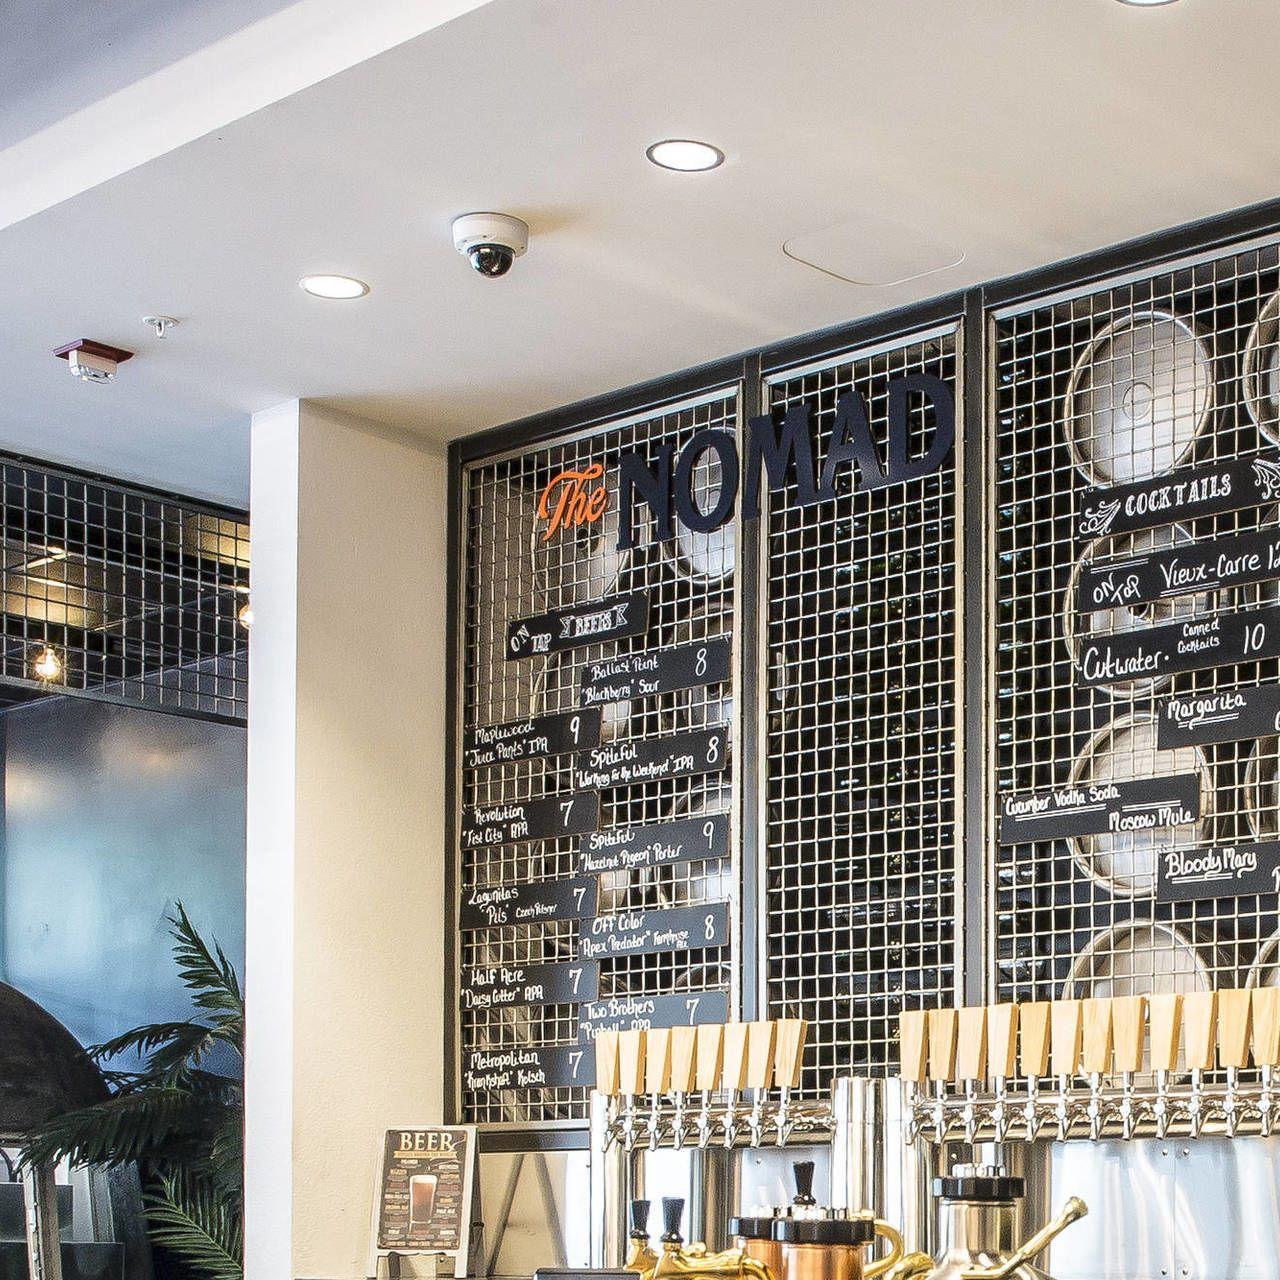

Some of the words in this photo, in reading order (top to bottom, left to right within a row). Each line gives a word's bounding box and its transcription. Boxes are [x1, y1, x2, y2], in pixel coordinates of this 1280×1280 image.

[539, 463, 607, 542] The
[617, 374, 955, 551] NOMAD
[1125, 473, 1232, 516] COCKTAILS
[1093, 572, 1114, 603] ON
[510, 624, 530, 652] ON
[531, 633, 552, 652] TAP
[575, 612, 612, 636] BEERS
[1183, 618, 1221, 638] Canned
[1083, 647, 1161, 681] Cutwater
[1243, 623, 1265, 655] 10
[1177, 637, 1221, 654] Cocktails
[591, 659, 631, 682] Ballast
[632, 655, 659, 672] Point
[695, 648, 707, 676] 8
[639, 679, 660, 694] Sour
[1167, 692, 1247, 727] Margarita
[475, 721, 535, 745] Maplewood
[570, 716, 580, 744] 9
[528, 737, 549, 754] IPA
[706, 736, 719, 763] 8
[673, 755, 694, 773] IPA
[474, 805, 526, 825] Revolution
[560, 800, 574, 827] 7
[1005, 795, 1051, 816] Cucumber
[1054, 789, 1086, 808] Vodka
[1089, 784, 1121, 801] Soda
[510, 821, 529, 839] APA
[1108, 812, 1156, 832] Moscow
[1158, 808, 1196, 826] Mule
[703, 821, 714, 849] 9
[653, 842, 683, 862] Porter
[1164, 849, 1222, 879] Bloody
[1222, 848, 1258, 878] Mary
[468, 887, 519, 912] Lagunitas
[573, 887, 587, 912] 7
[618, 913, 646, 932] Color
[704, 914, 715, 940] 8
[500, 967, 526, 985] Acre
[568, 967, 583, 995] 7
[525, 984, 544, 1001] APA
[584, 1003, 607, 1020] Two
[608, 998, 655, 1018] Brothers
[686, 998, 700, 1026] 7
[471, 1050, 540, 1071] Metropolitan
[568, 1051, 583, 1078] 7
[400, 1132, 454, 1151] BEER
